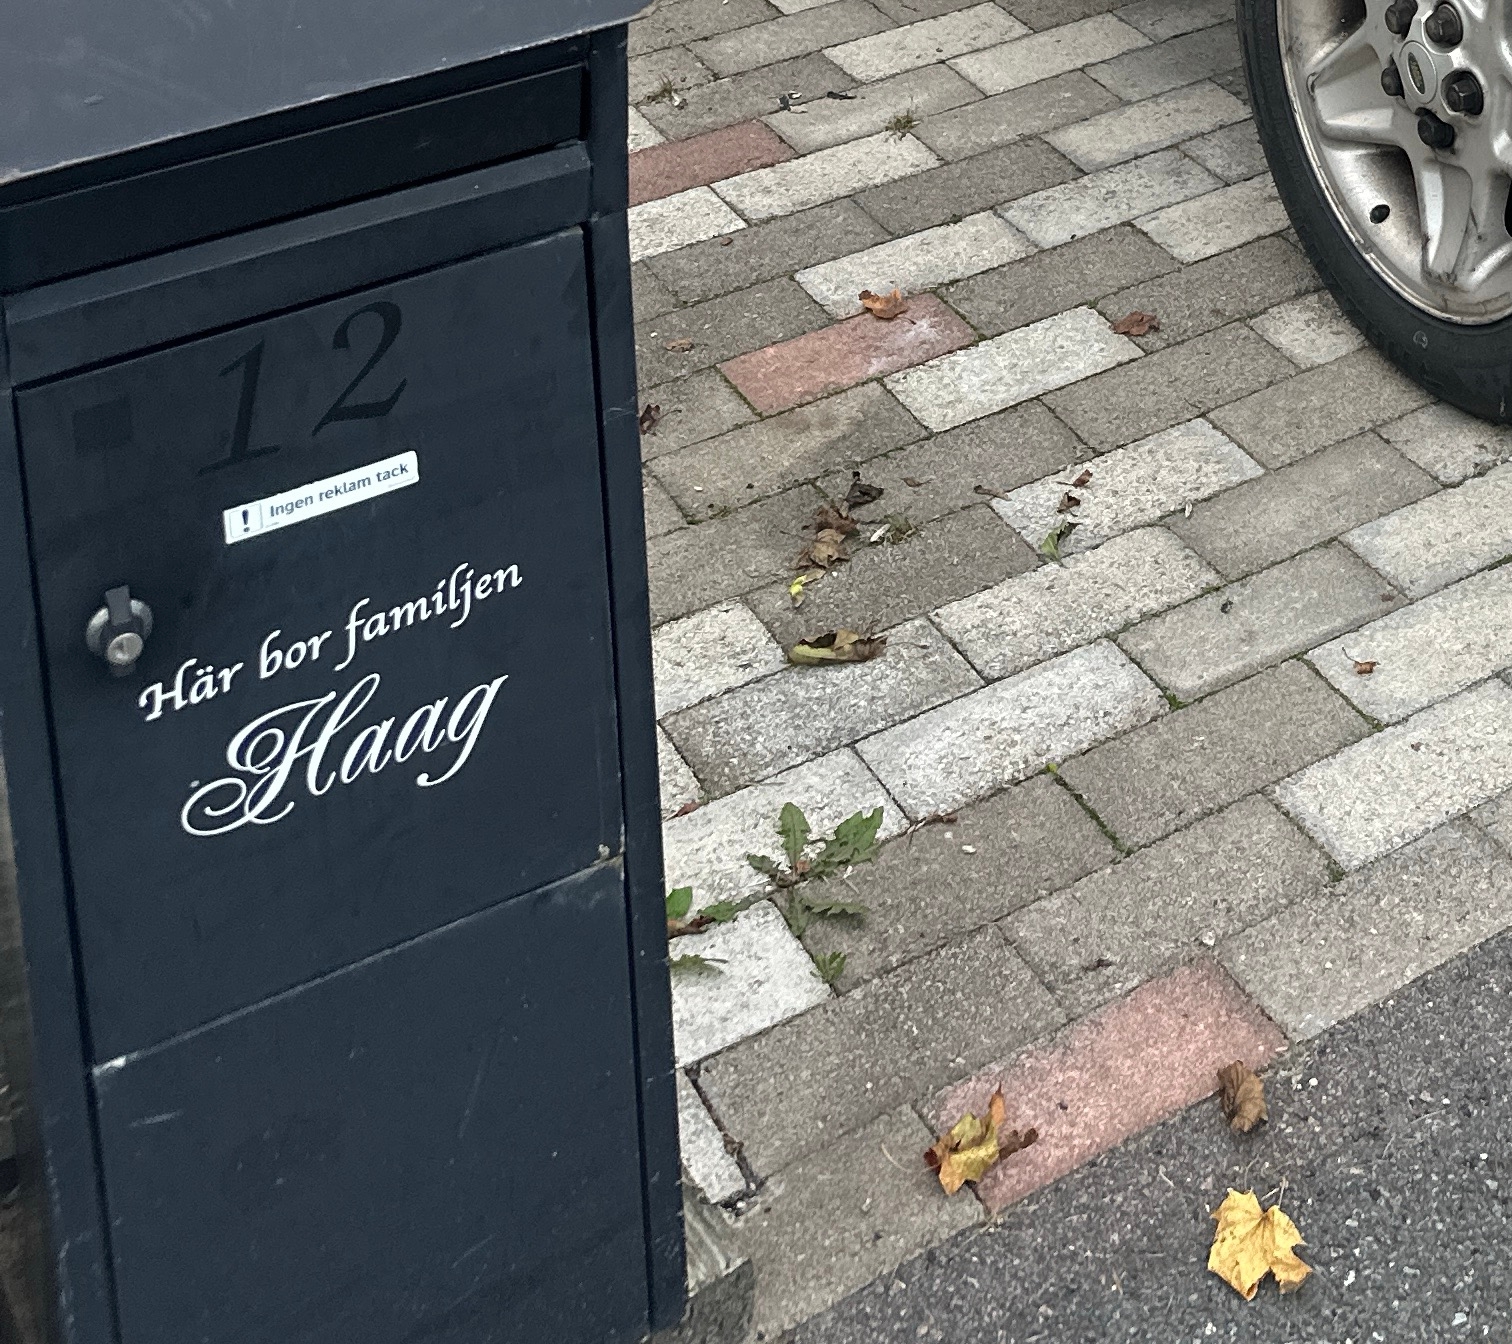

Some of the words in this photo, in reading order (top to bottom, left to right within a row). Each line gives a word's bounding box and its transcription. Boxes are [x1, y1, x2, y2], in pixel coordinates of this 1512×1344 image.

[198, 298, 410, 476] 12
[269, 495, 315, 517] Ingen
[317, 475, 372, 503] reklam
[375, 462, 410, 483] tack
[137, 656, 245, 723] Här
[258, 628, 333, 680] bor
[333, 561, 523, 673] familjen
[180, 671, 510, 837] Haag
